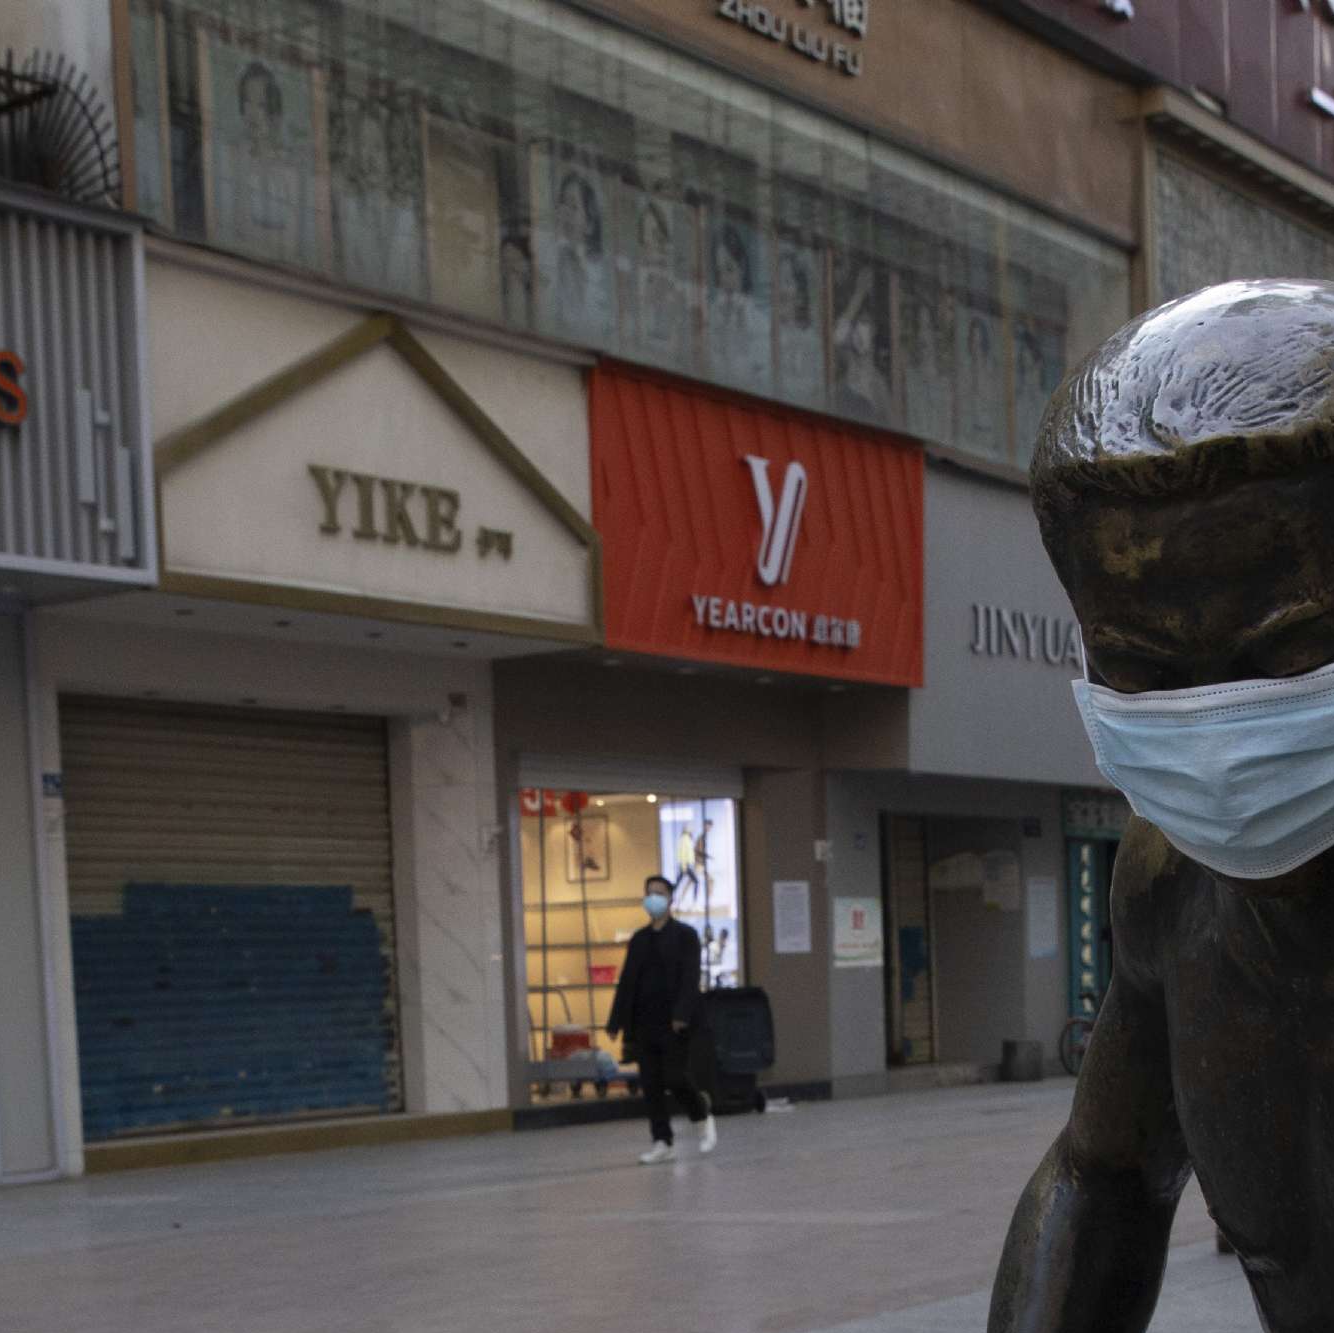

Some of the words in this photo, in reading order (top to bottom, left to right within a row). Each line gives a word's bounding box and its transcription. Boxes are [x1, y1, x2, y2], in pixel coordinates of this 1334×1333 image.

[833, 42, 863, 77] FU
[307, 463, 462, 555] YIKE
[691, 593, 807, 639] YEARCON
